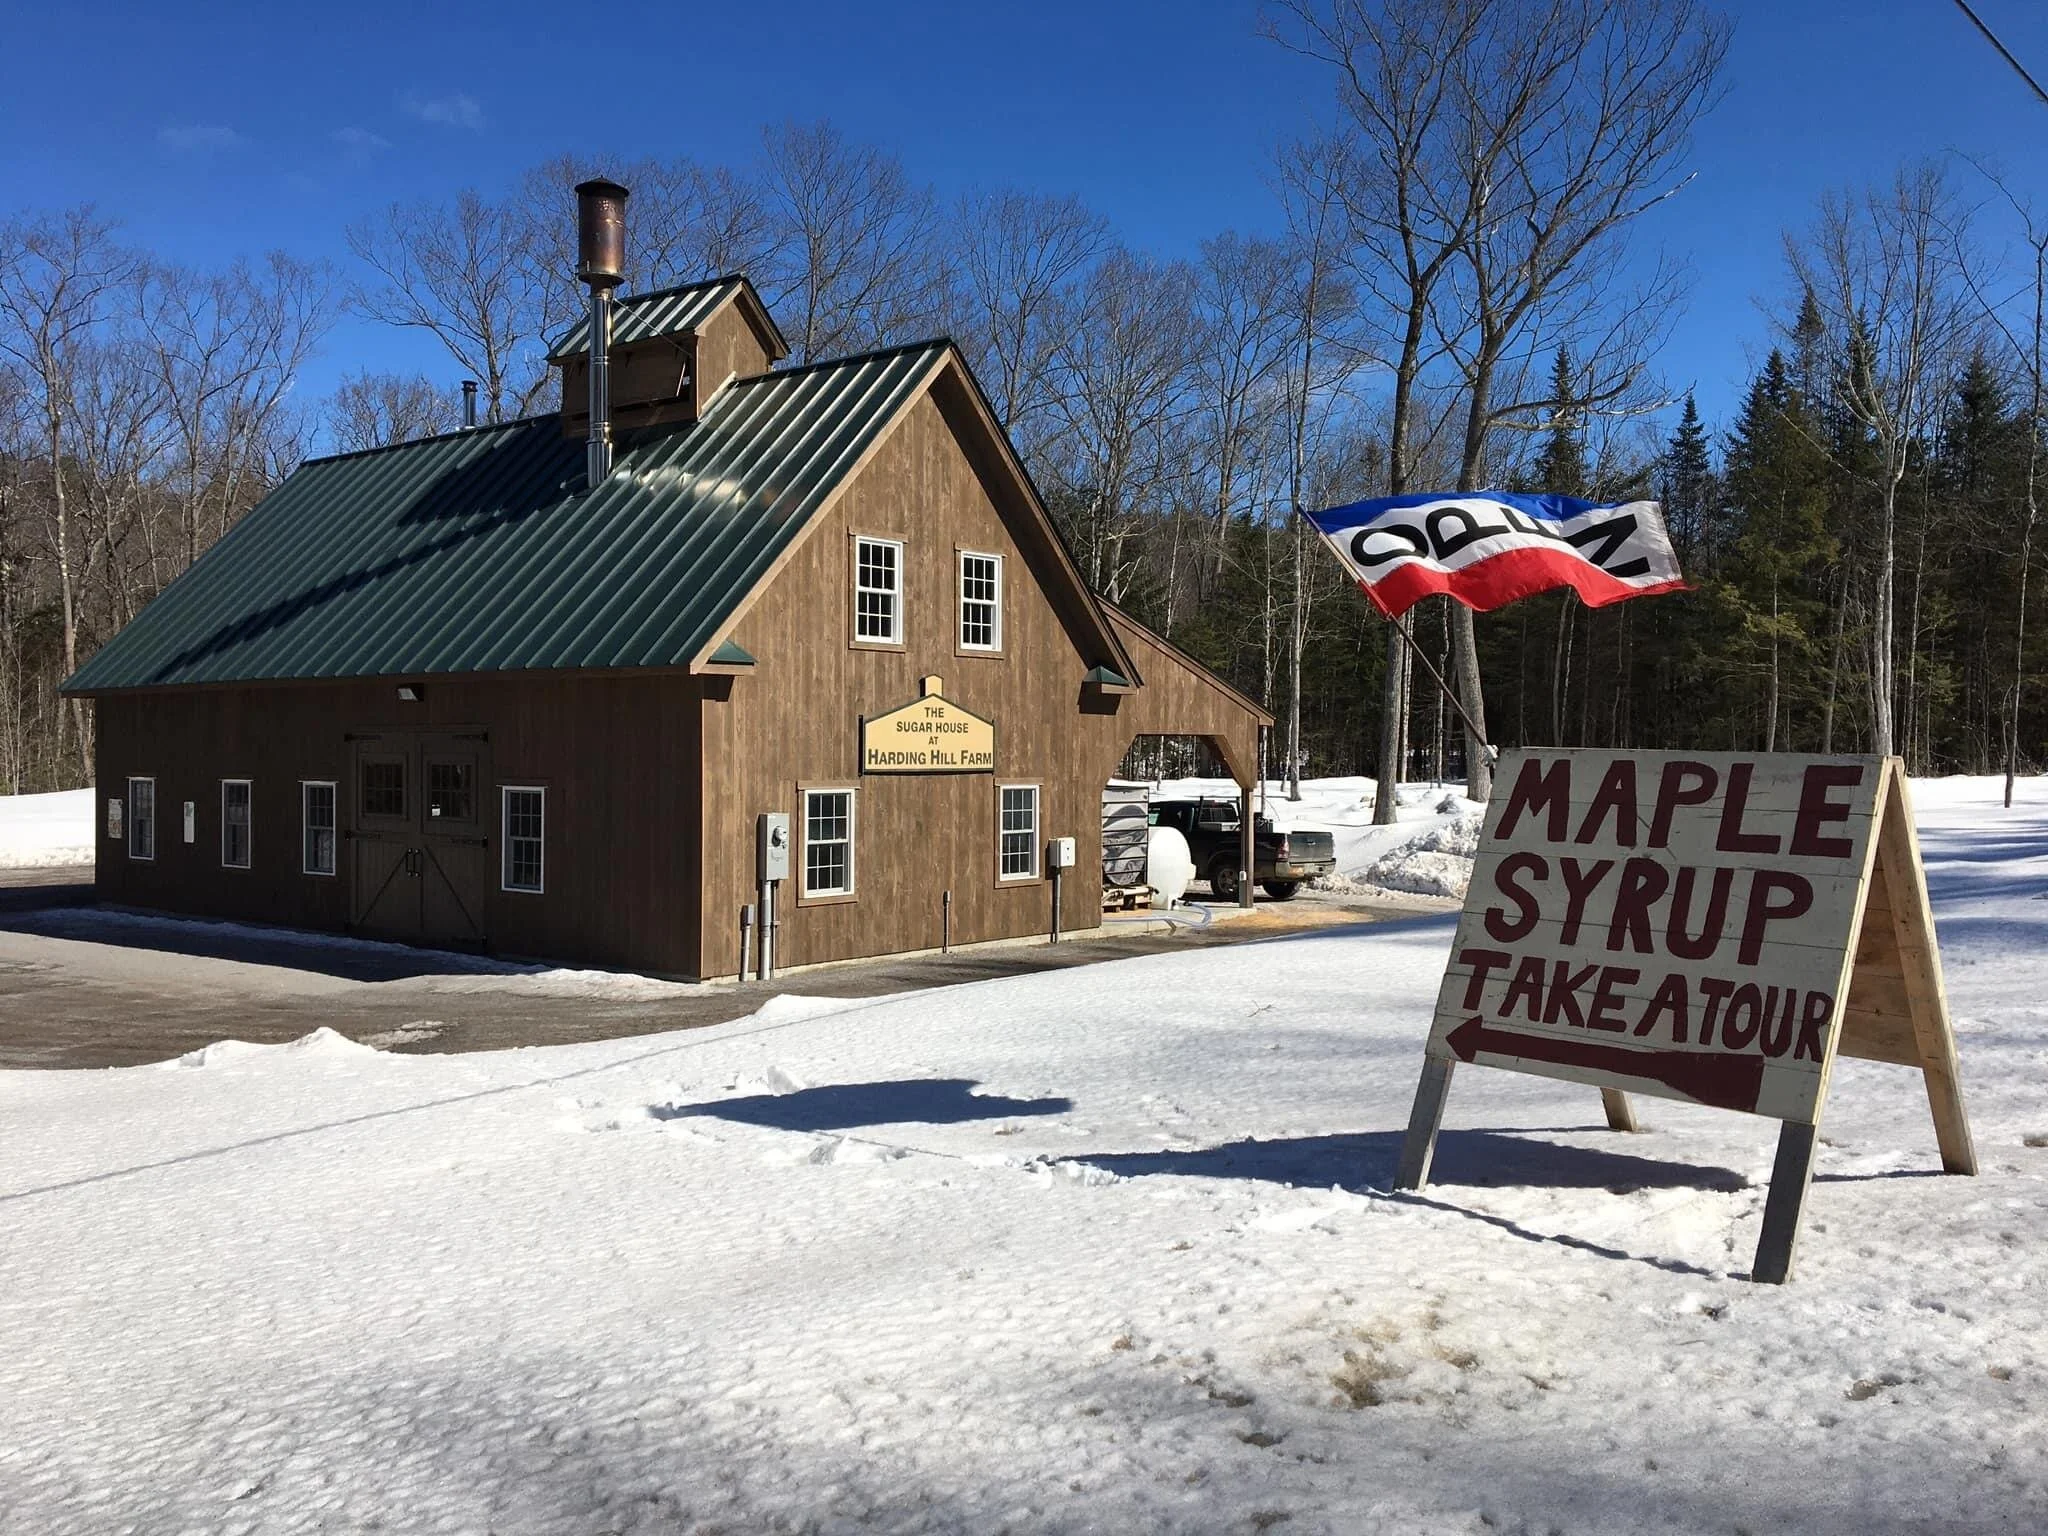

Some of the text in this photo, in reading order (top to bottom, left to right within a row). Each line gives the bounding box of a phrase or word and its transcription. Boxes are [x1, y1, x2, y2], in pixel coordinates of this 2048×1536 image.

[1349, 506, 1651, 578] OPEN
[896, 721, 969, 734] SUGAR HOUSE
[924, 706, 945, 719] THE
[868, 748, 992, 765] HARDING HILL FARM
[928, 735, 939, 746] AT
[1494, 758, 1864, 858] MAPLE
[1483, 850, 1815, 966] SYRUP
[1458, 948, 1836, 1064] TAKE A TOUR
